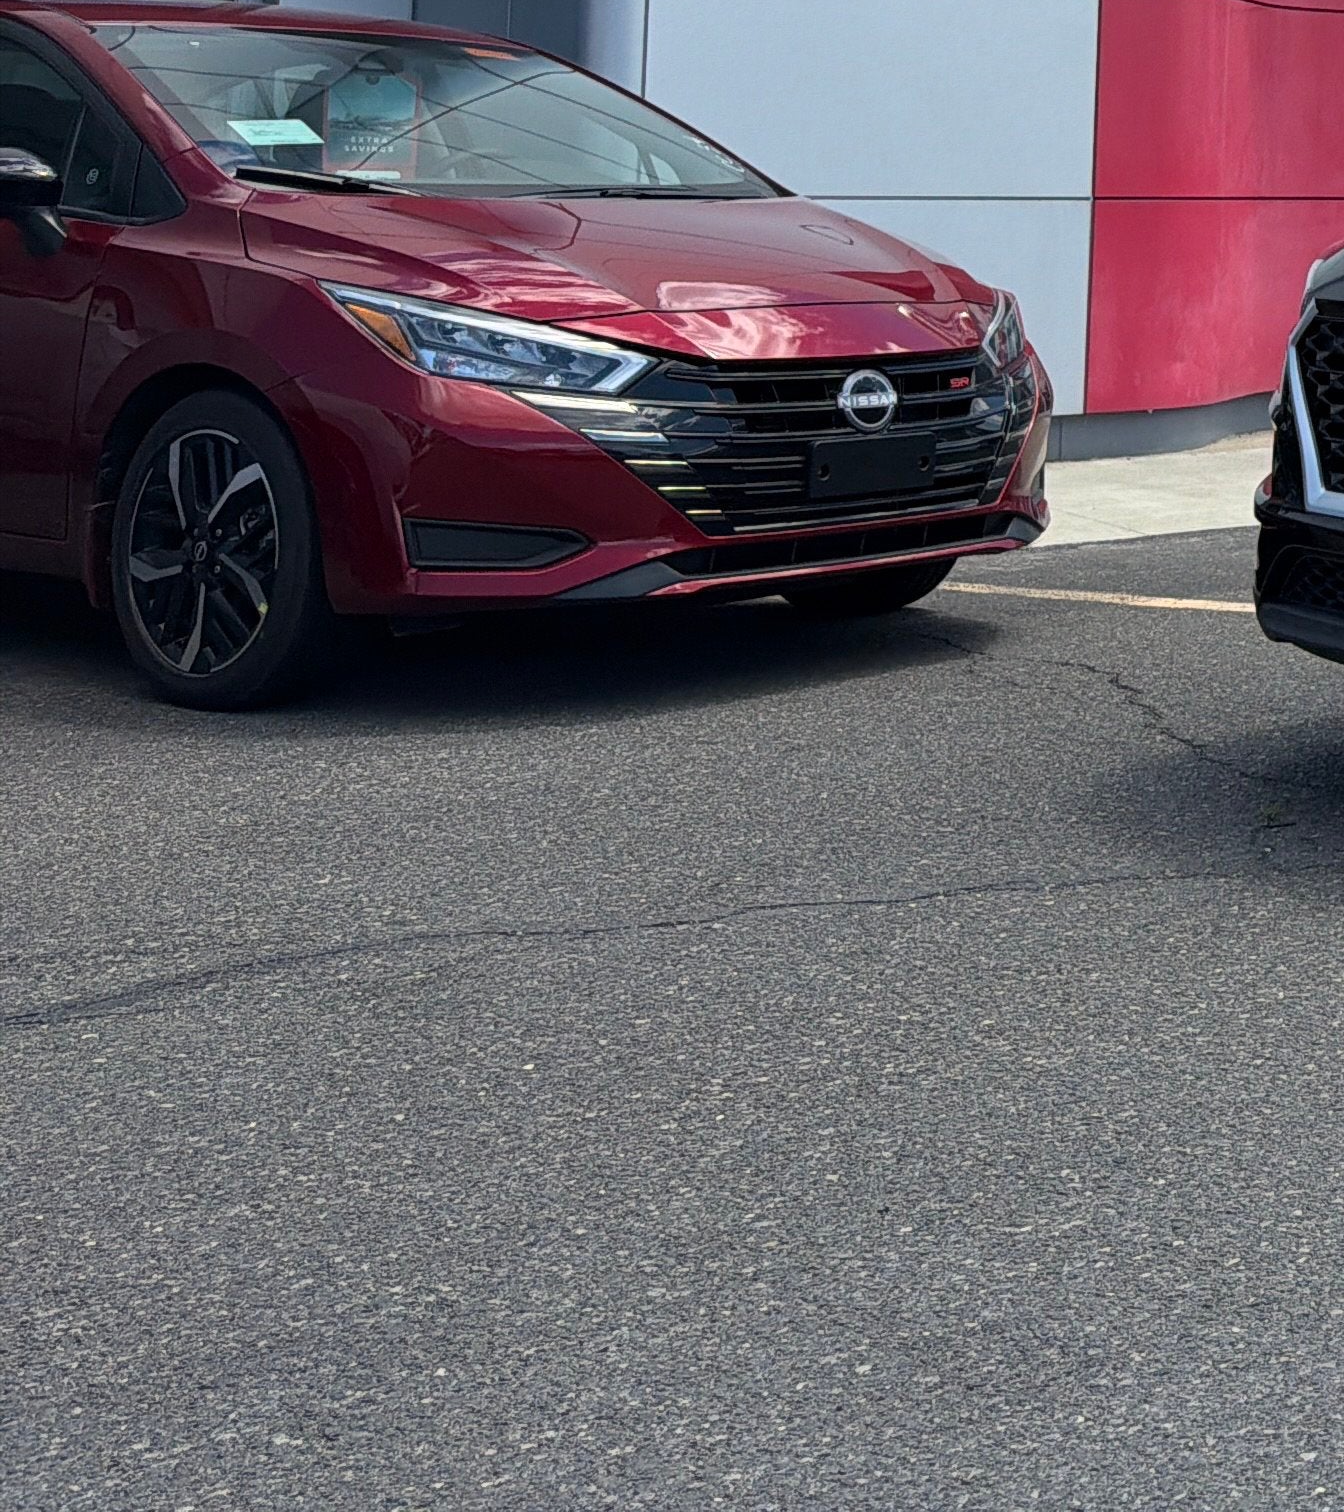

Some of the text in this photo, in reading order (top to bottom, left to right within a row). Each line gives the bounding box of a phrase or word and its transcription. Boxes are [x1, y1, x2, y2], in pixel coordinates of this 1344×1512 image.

[350, 136, 389, 144] EXTRA
[344, 145, 394, 153] SAVINGS
[949, 376, 970, 388] SR
[838, 393, 898, 409] NISSAN
